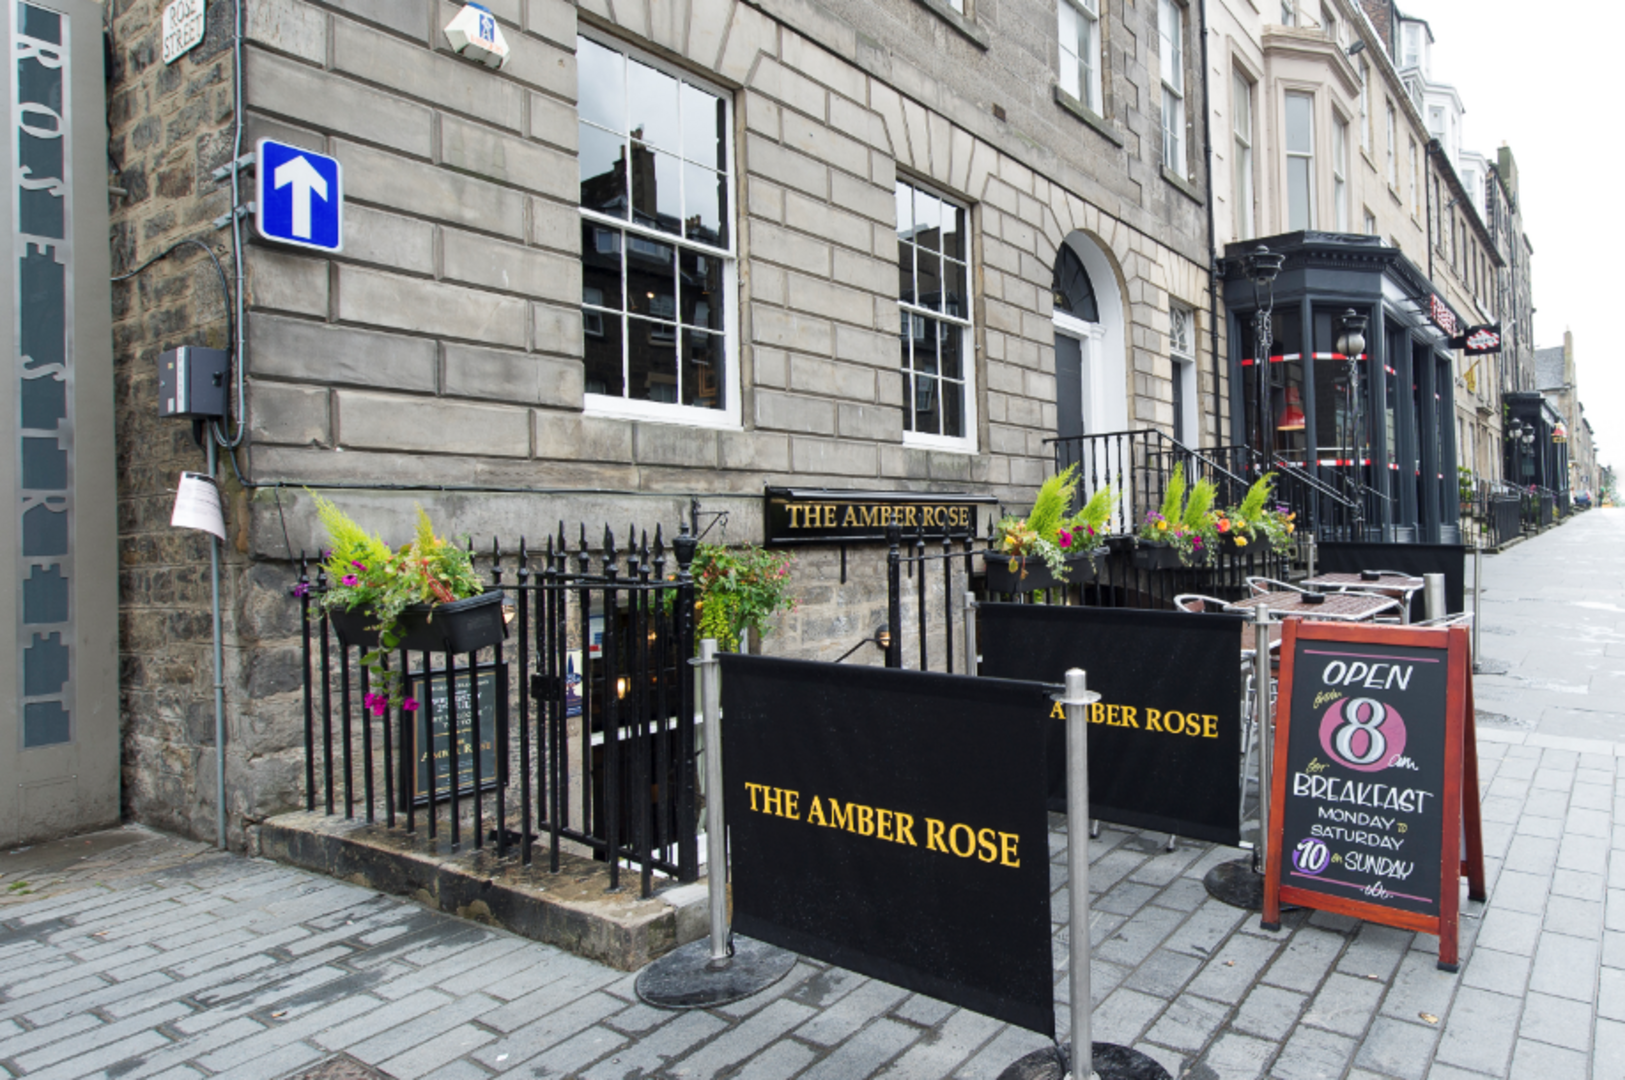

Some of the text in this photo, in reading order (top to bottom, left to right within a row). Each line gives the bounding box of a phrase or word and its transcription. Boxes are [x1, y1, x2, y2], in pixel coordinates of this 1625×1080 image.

[169, 0, 197, 28] ROSE
[164, 13, 203, 58] STREET
[18, 33, 72, 715] ROSE STREET
[785, 504, 970, 528] THE AMBER ROSE
[1321, 659, 1414, 692] OPEN
[1049, 700, 1219, 739] ABER ROSE
[1334, 696, 1386, 764] 8
[1292, 771, 1435, 814] BREAKFAST
[744, 781, 1021, 868] THE AMBER ROSE
[1310, 823, 1405, 851] SATURDAY
[1317, 805, 1396, 831] MONDAY
[1296, 840, 1329, 871] 10
[1343, 850, 1415, 881] SUNDAY
